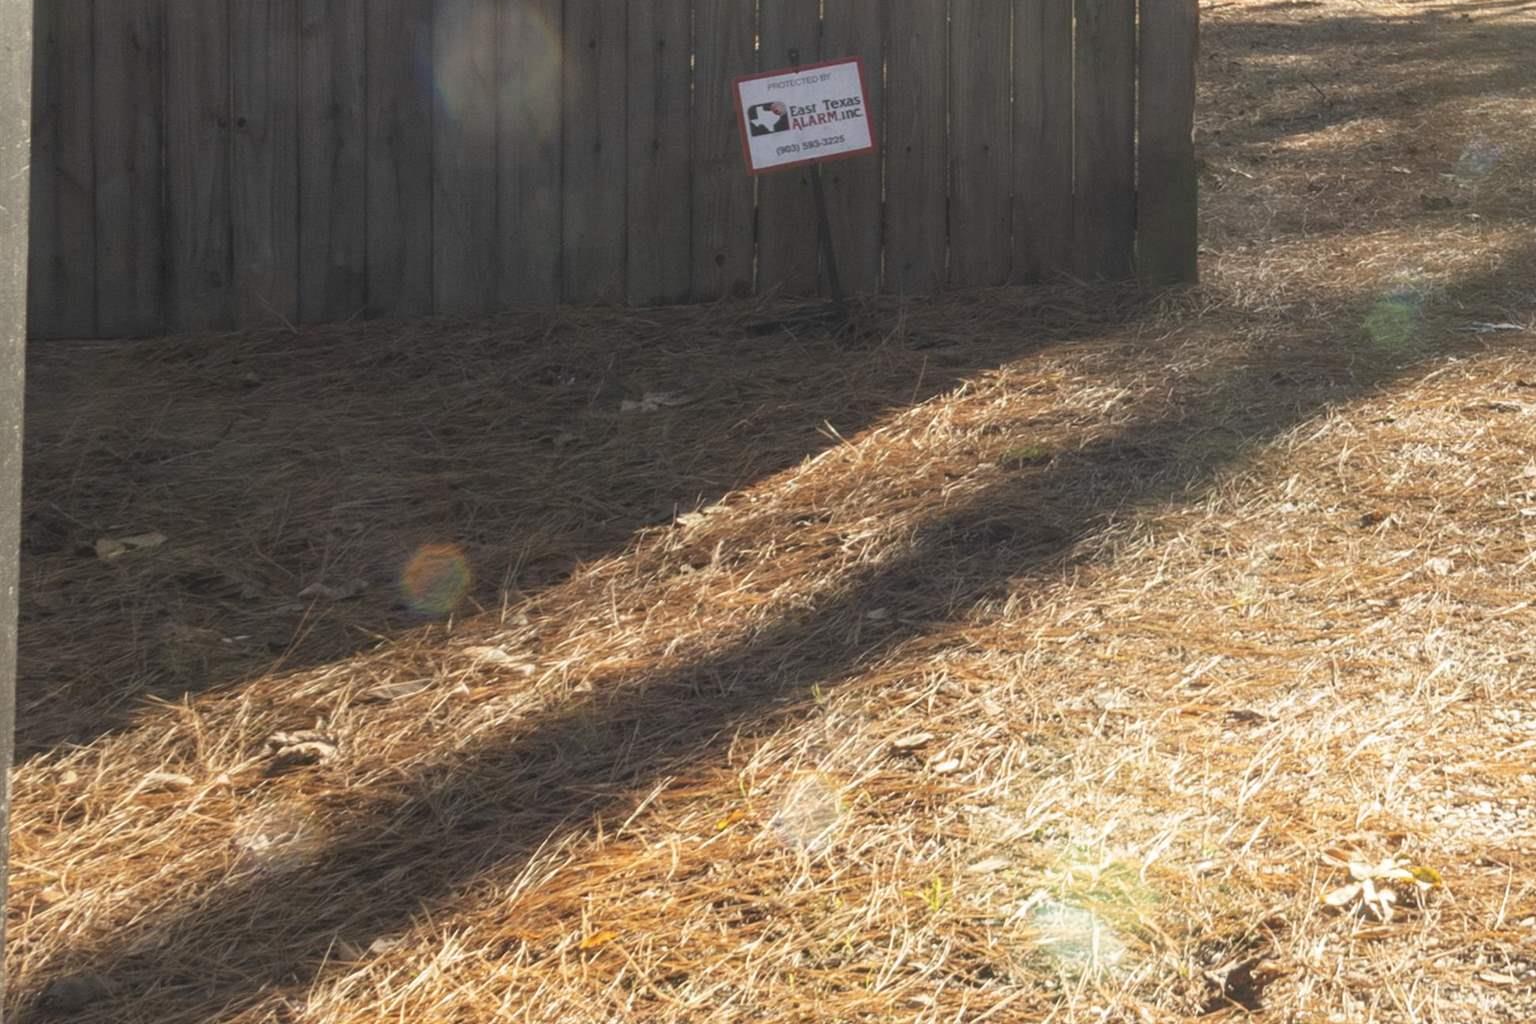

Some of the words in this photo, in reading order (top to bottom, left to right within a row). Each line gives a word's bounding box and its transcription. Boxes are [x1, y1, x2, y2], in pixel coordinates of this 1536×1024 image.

[767, 75, 818, 91] PROTECTED
[819, 72, 831, 84] BY
[789, 103, 817, 118] East
[822, 95, 861, 111] Texas
